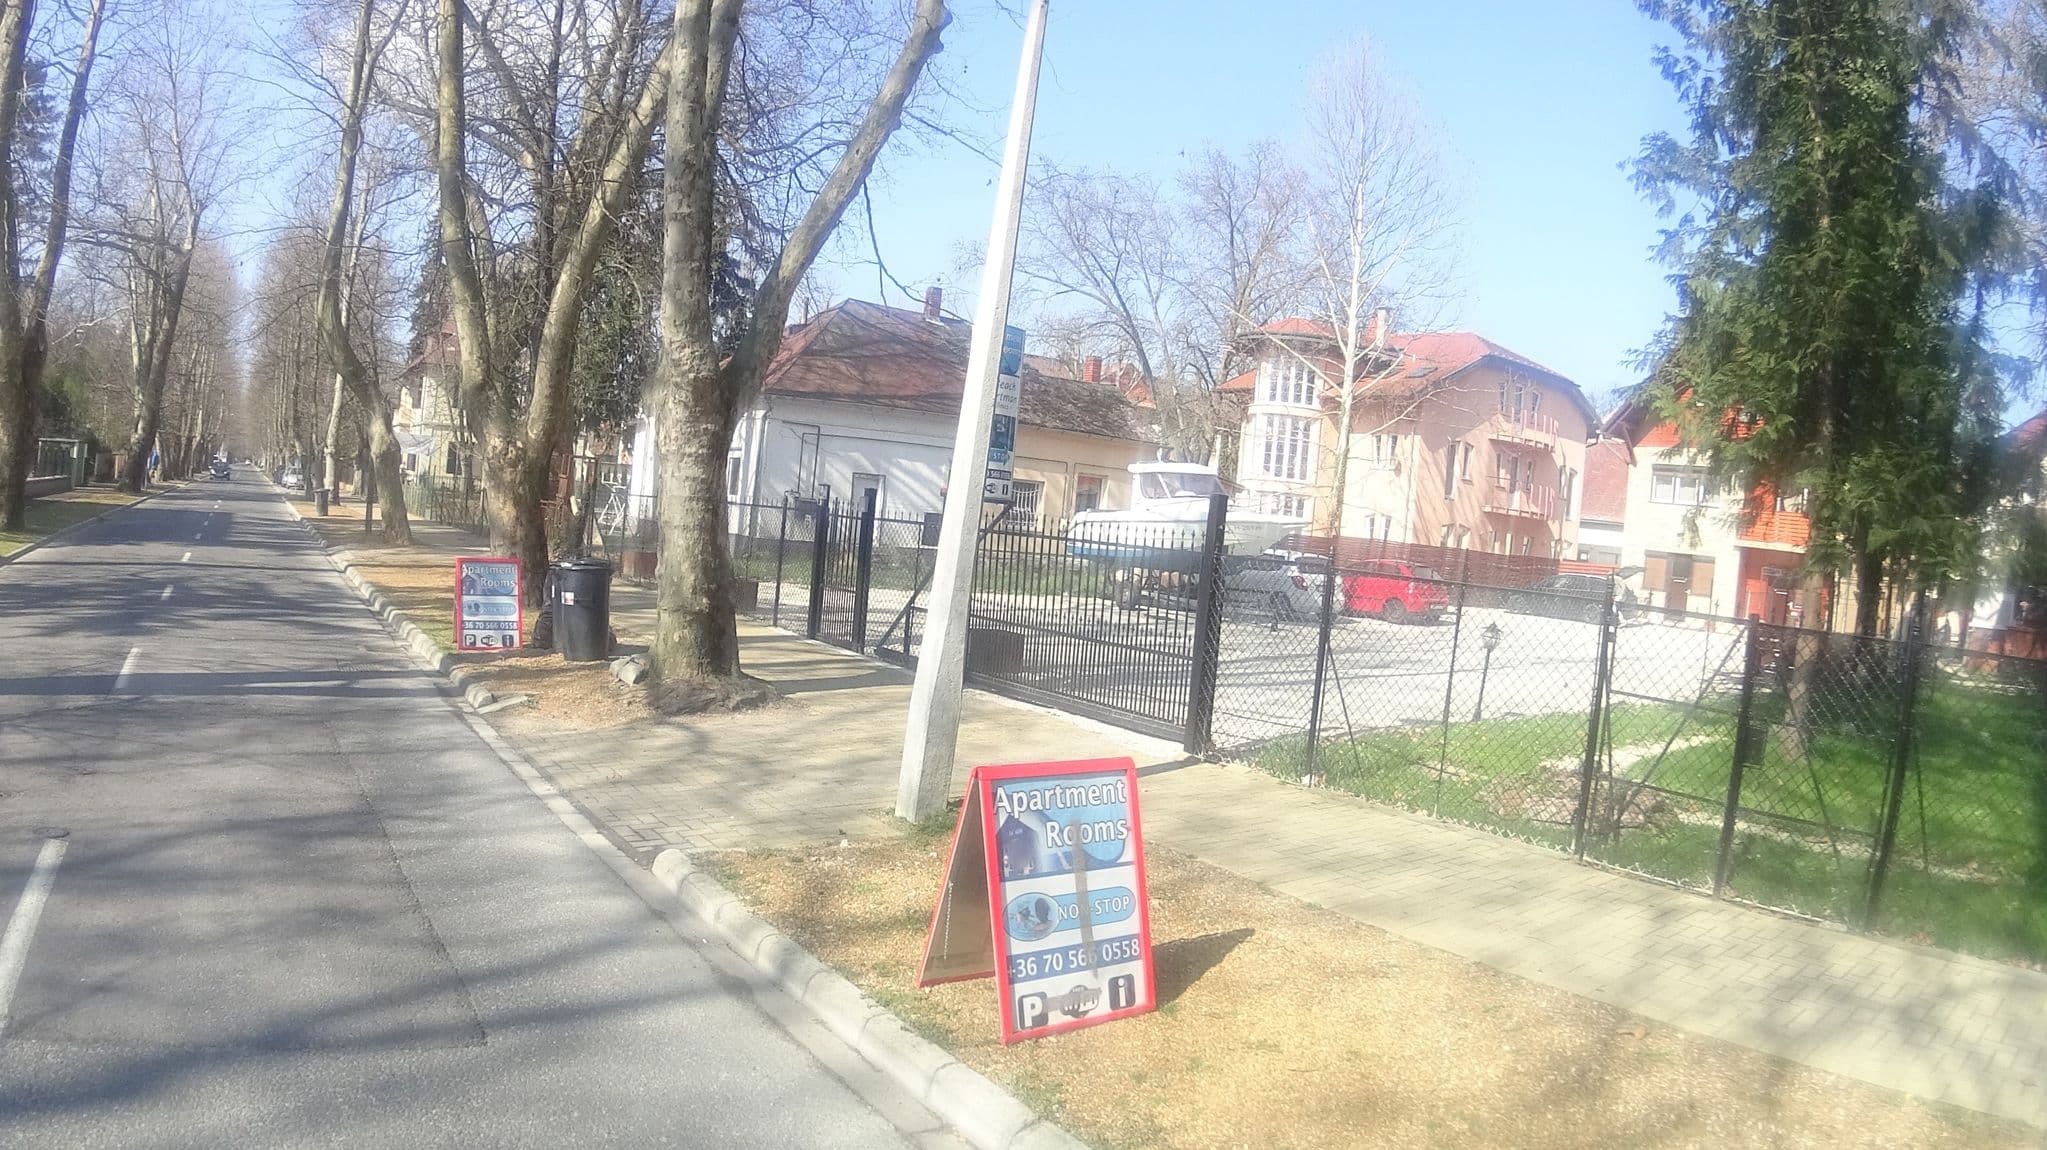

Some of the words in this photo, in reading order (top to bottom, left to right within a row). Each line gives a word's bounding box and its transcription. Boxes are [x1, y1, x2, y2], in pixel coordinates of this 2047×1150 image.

[462, 563, 518, 576] Apartment
[480, 577, 515, 587] Rooms
[993, 780, 1128, 819] Apartment
[1045, 819, 1129, 848] Rooms
[1058, 896, 1130, 921] NO-STOP
[1043, 952, 1063, 973] 70
[1102, 938, 1140, 961] 0558
[1022, 996, 1043, 1027] P
